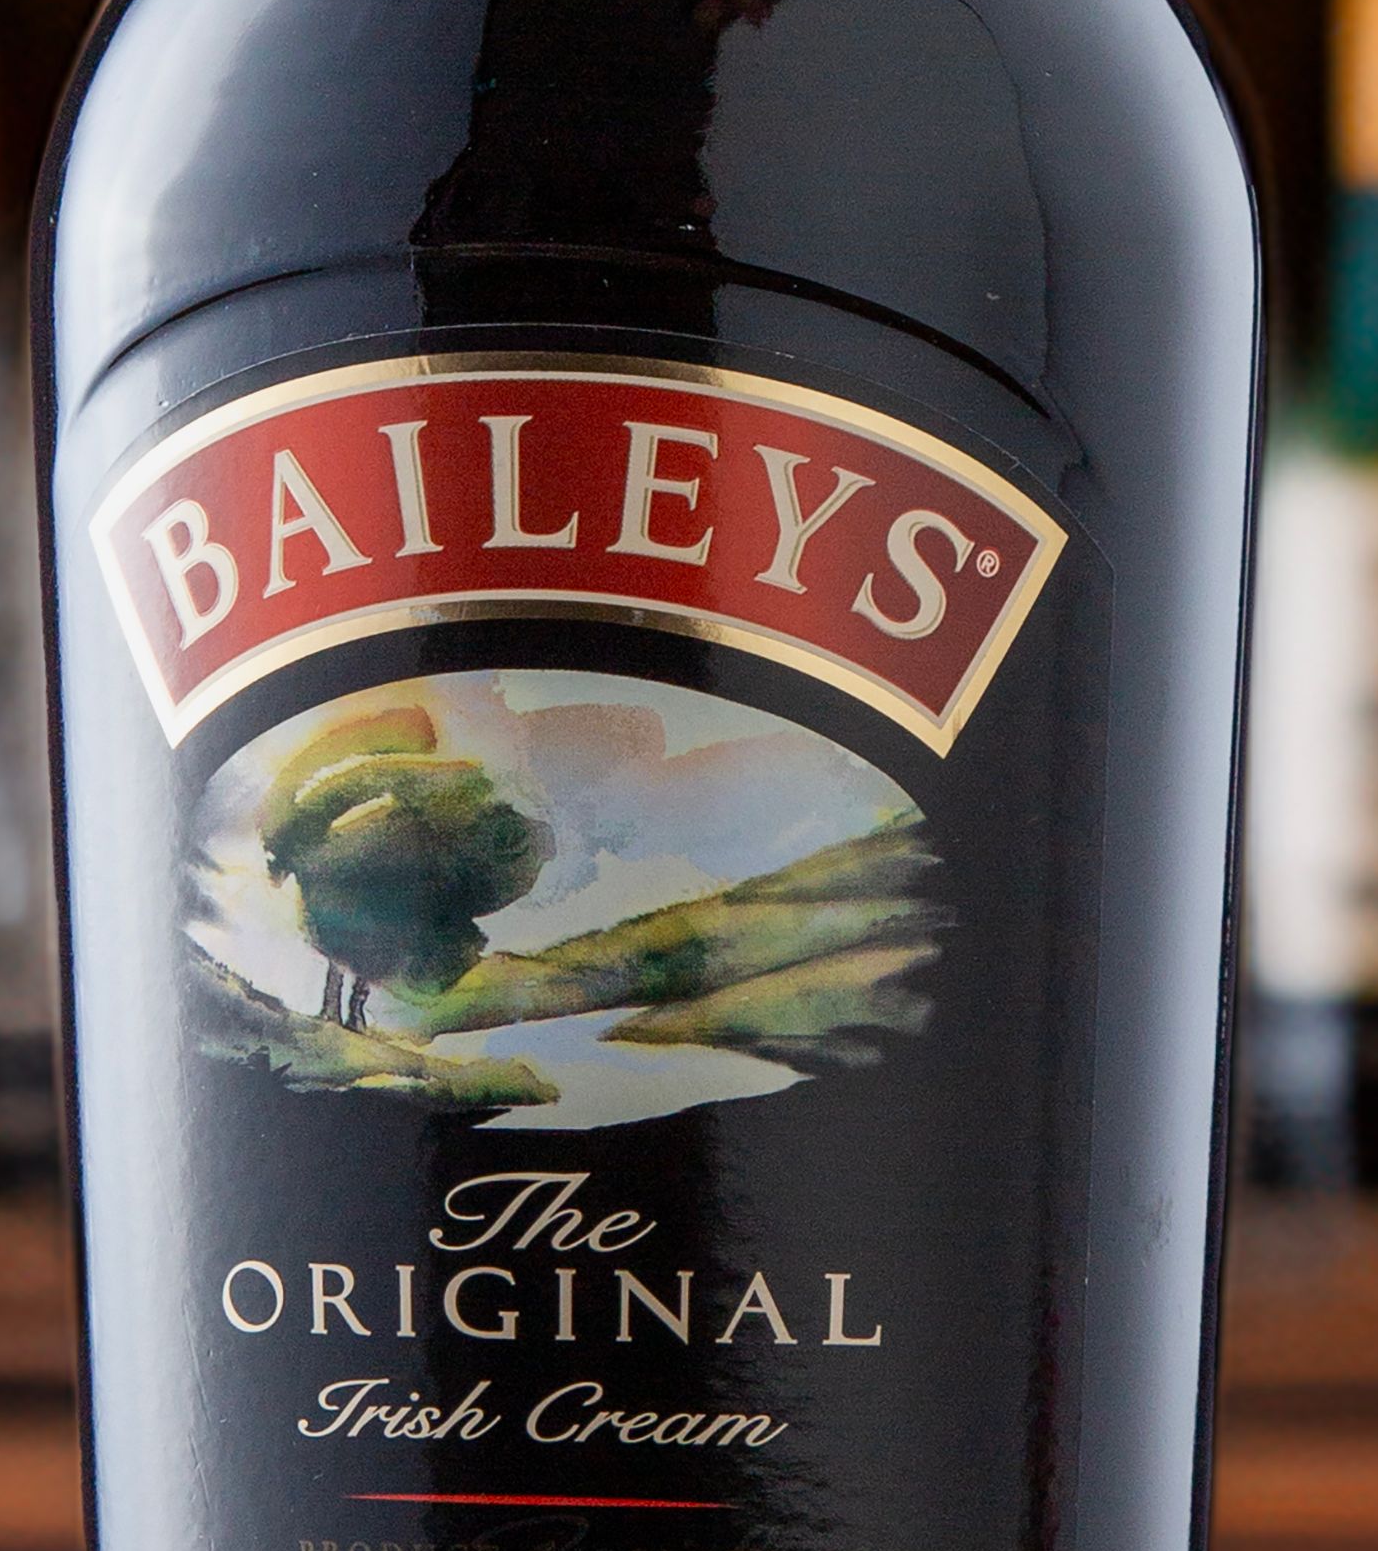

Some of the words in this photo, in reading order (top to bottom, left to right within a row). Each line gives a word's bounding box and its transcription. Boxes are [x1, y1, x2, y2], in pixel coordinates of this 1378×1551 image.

[429, 1171, 657, 1252] The
[222, 1260, 881, 1347] ORIGINAL
[297, 1379, 501, 1441] Irish
[526, 1381, 787, 1448] Cream
